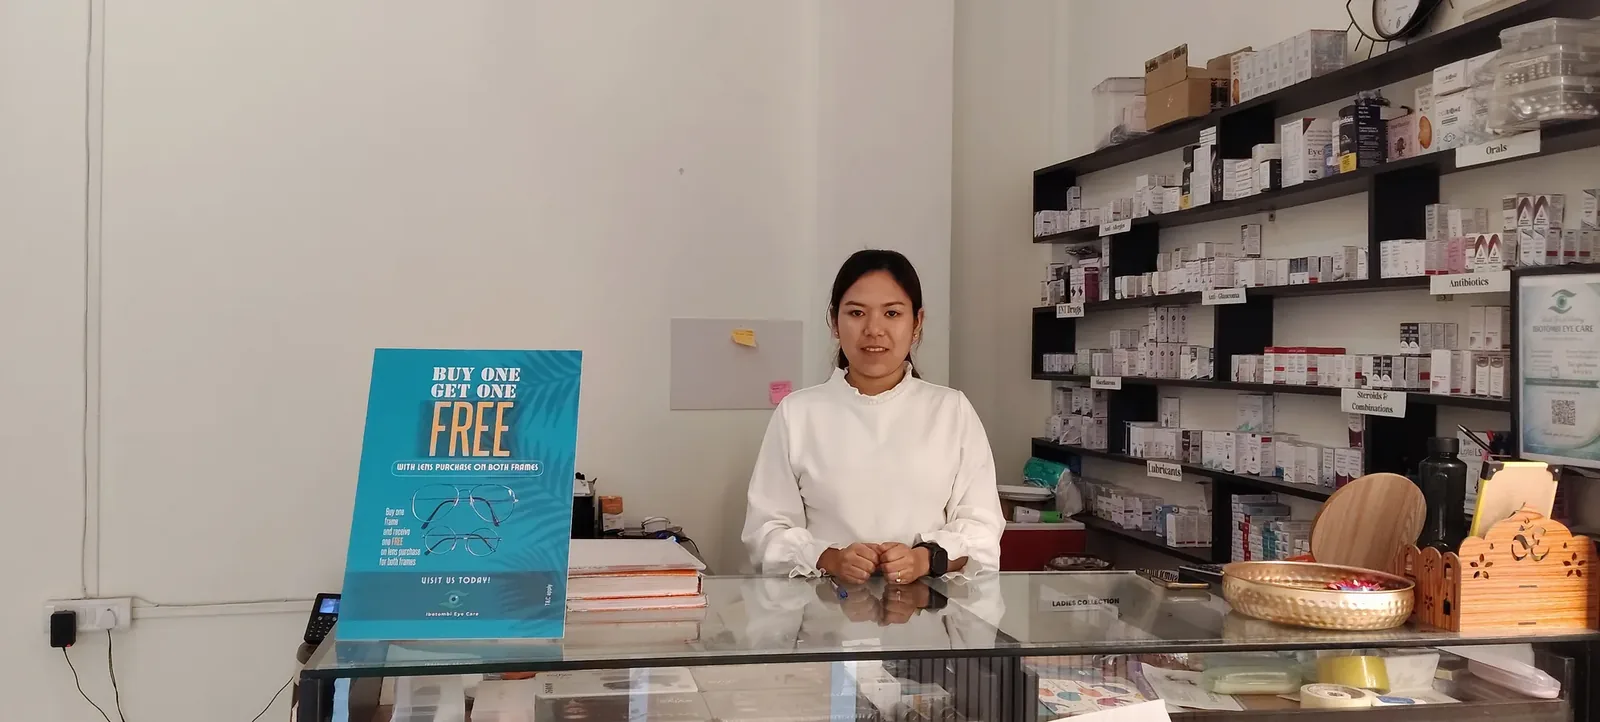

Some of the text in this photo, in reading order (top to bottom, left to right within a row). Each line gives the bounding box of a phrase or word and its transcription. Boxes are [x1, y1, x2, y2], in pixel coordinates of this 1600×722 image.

[1485, 143, 1508, 155] Orals
[1449, 277, 1490, 288] Antibiotics
[432, 366, 521, 382] BUY ONE
[430, 384, 517, 398] GET ONE
[1356, 390, 1382, 400] Steroids
[1352, 402, 1394, 414] Combinations
[428, 401, 515, 457] FREE
[1148, 462, 1182, 478] Lubricants
[385, 508, 405, 516] Buy one
[384, 517, 399, 525] frame
[383, 528, 410, 536] and receive
[382, 537, 404, 546] one FREE
[380, 548, 421, 557] on lens purchase
[379, 558, 416, 566] for both frames
[446, 576, 456, 584] US
[458, 576, 491, 584] TODAY!
[1077, 598, 1120, 606] COLLECTION
